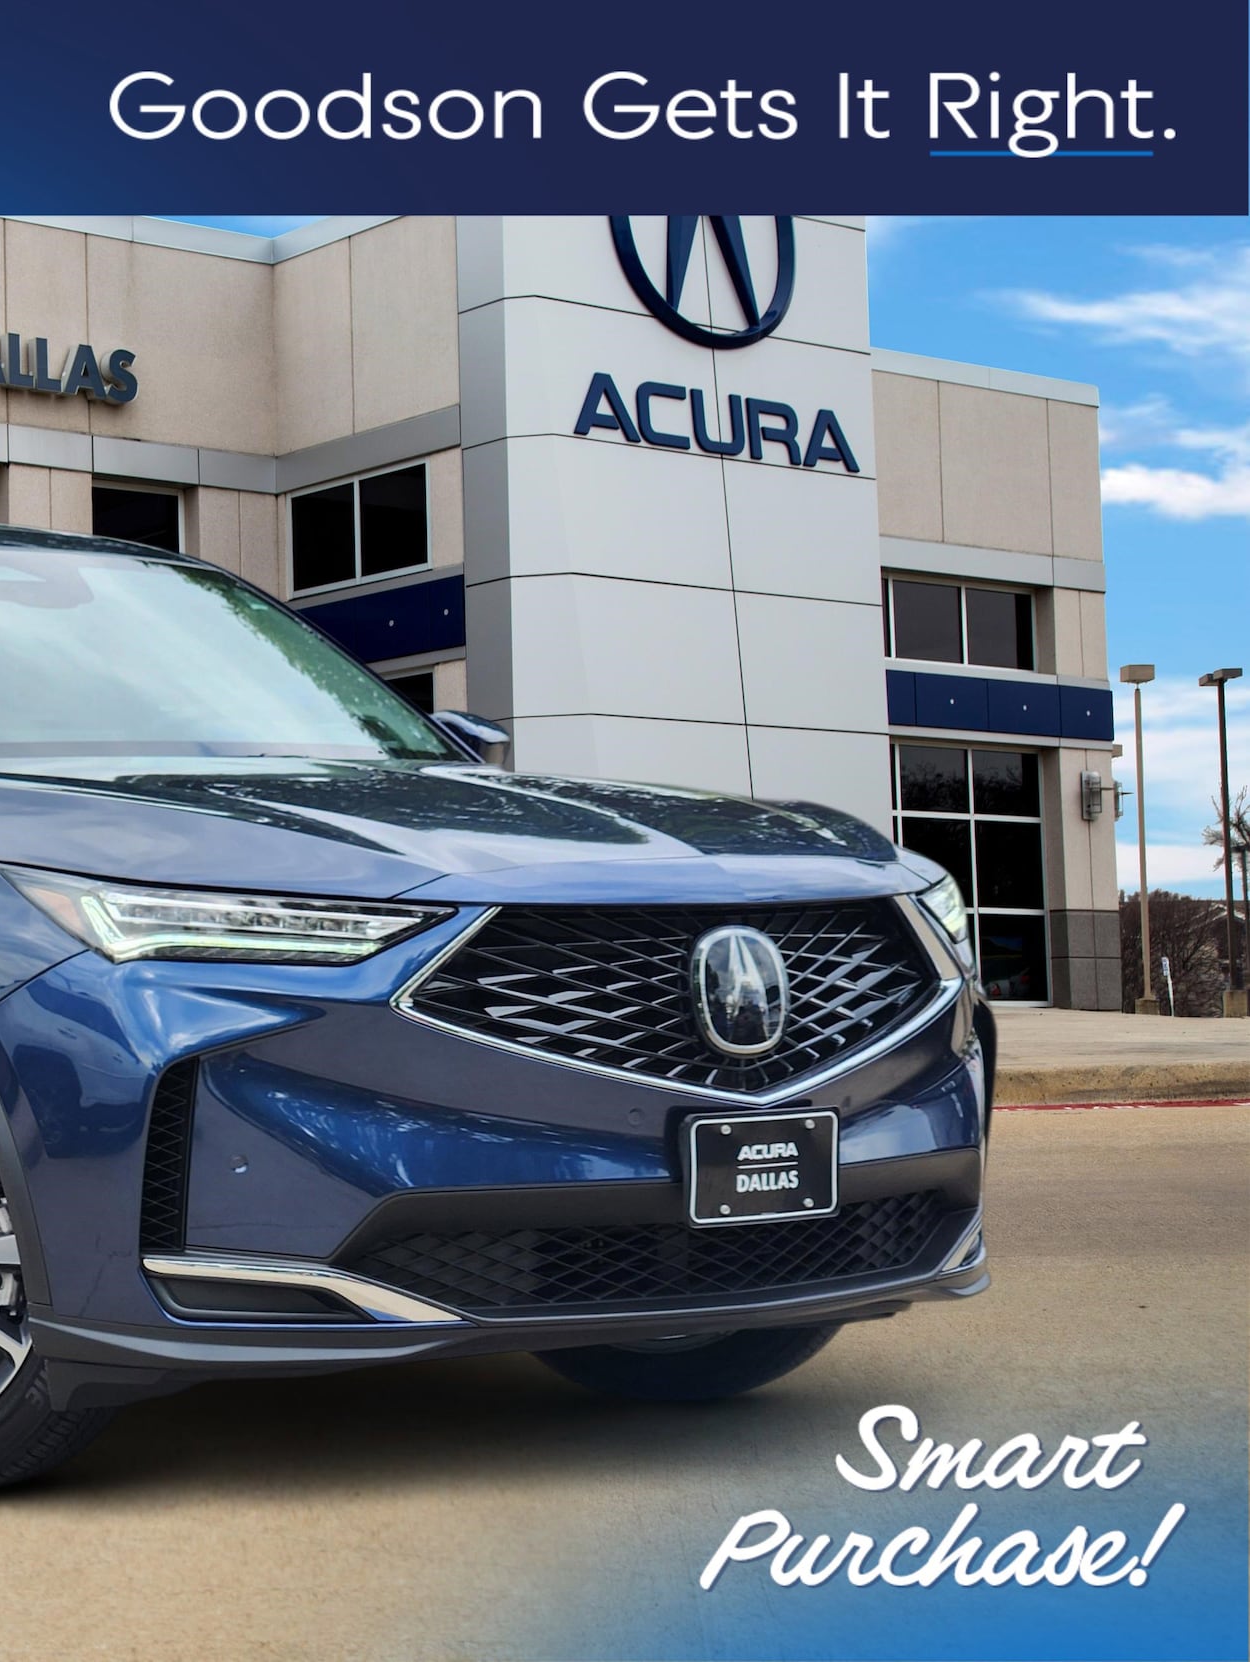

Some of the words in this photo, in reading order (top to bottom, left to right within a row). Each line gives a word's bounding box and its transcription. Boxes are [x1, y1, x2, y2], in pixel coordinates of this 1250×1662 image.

[573, 371, 860, 473] ACURA
[736, 1141, 799, 1162] ACURA
[735, 1170, 800, 1194] DALLAS
